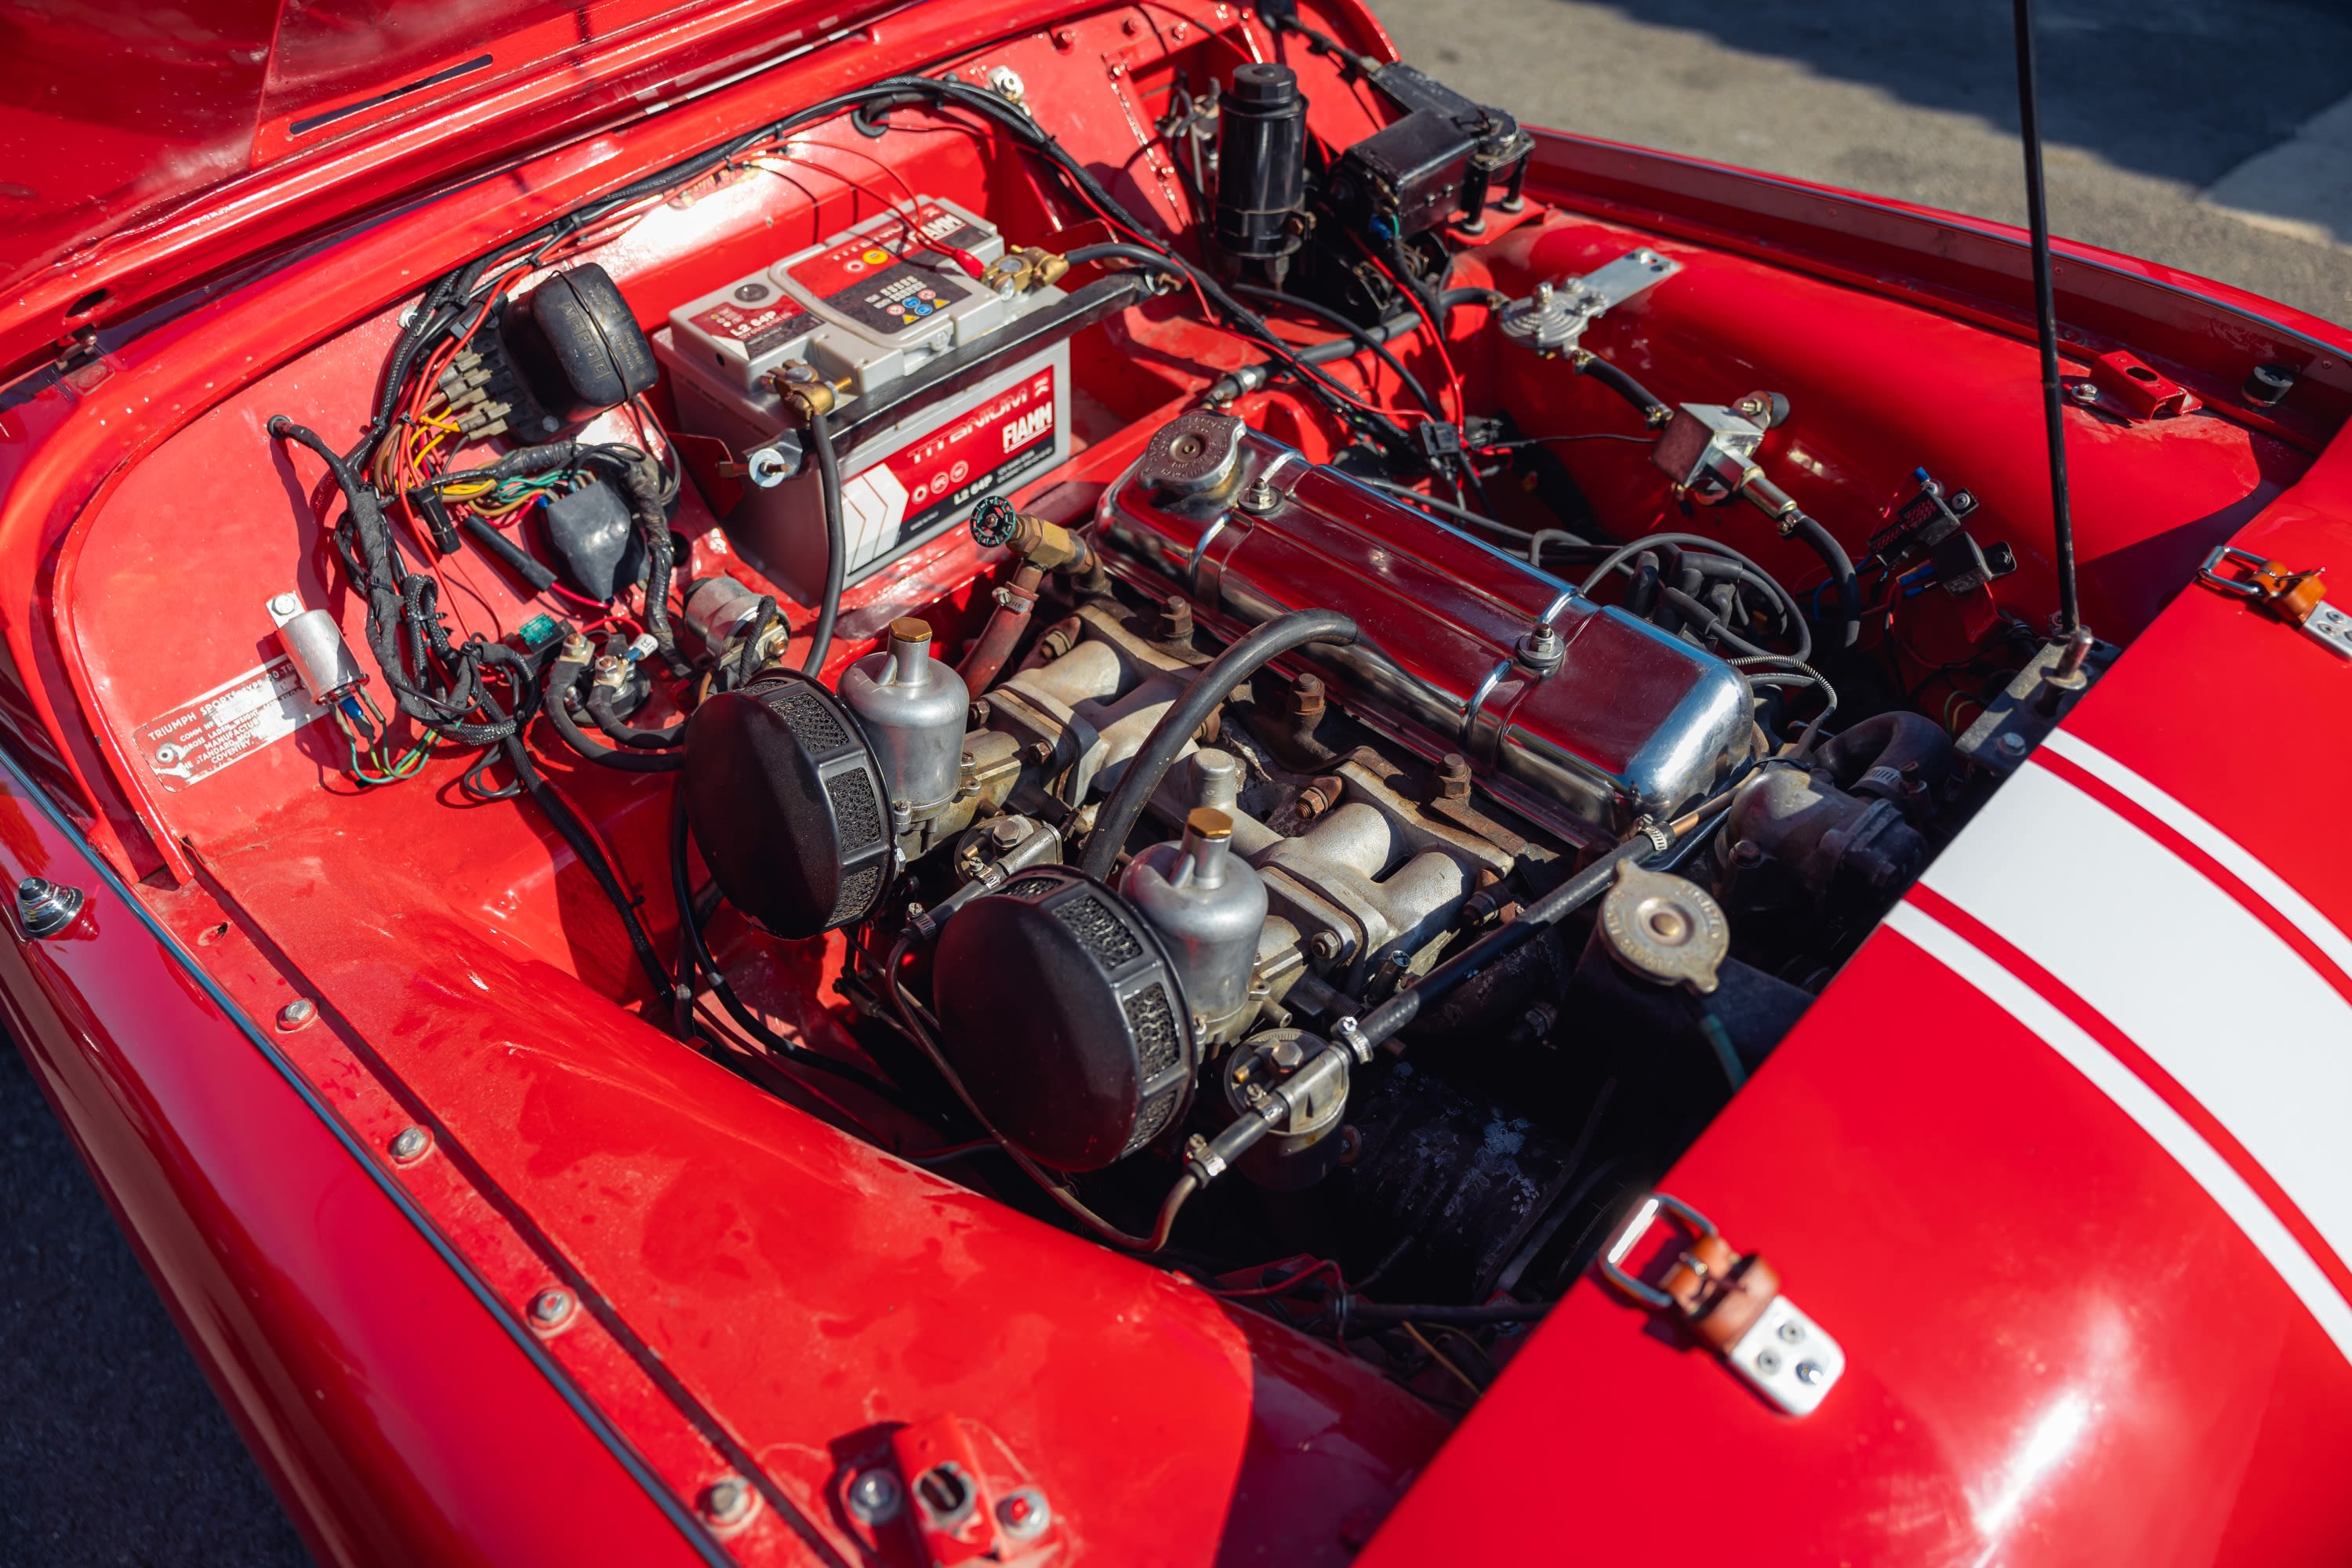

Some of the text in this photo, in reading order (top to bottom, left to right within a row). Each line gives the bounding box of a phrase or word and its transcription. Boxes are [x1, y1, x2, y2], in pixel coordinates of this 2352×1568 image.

[908, 213, 965, 245] FAMM
[907, 388, 1028, 464] TITANIUM
[1003, 401, 1052, 454] FIAMM
[147, 712, 197, 741] TRIUMPH
[180, 727, 203, 742] COMM
[183, 736, 205, 752] GROSS
[208, 723, 233, 739] LADEN
[233, 708, 260, 726] WEIGHT
